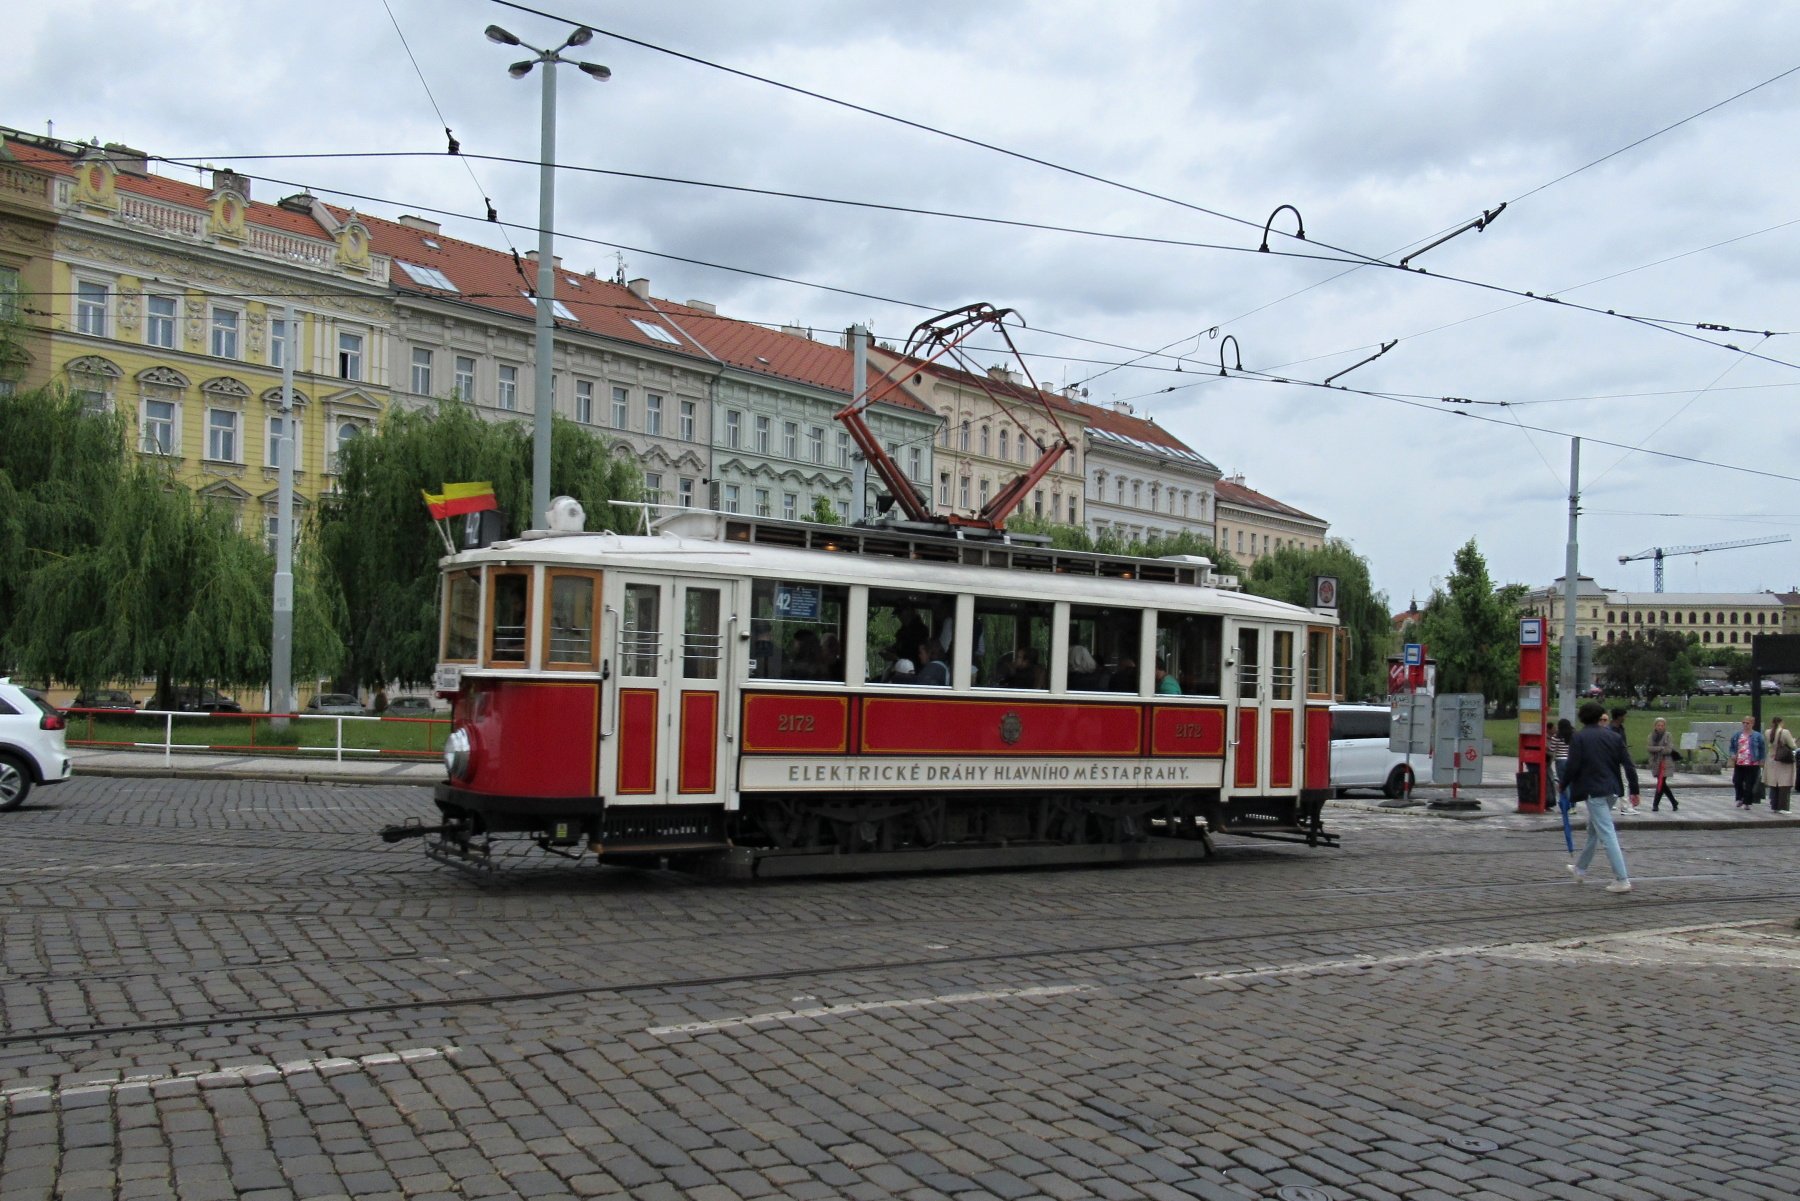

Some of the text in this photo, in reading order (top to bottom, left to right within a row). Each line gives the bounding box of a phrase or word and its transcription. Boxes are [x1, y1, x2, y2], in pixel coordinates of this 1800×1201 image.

[776, 592, 790, 610] 42
[778, 714, 815, 732] 2172
[1176, 723, 1202, 738] 2172
[788, 763, 1190, 781] ELEKTRICKÉ DRÁHY HLAVNÍHO MĚSTA PRAHY.
